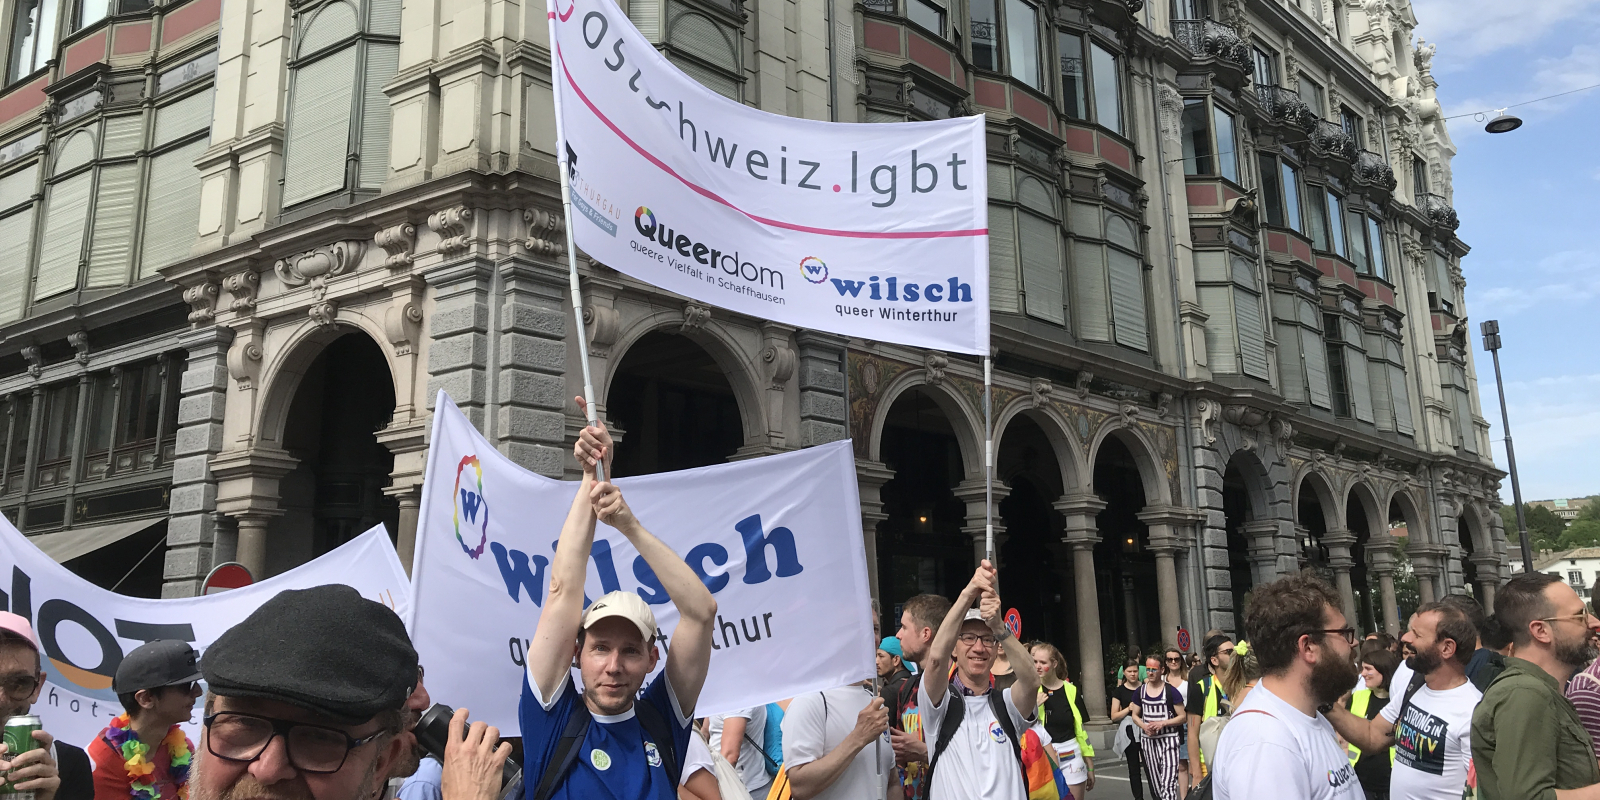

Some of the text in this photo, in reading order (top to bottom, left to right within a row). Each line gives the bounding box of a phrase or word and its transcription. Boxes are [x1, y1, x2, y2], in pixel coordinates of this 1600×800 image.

[580, 177, 621, 220] THURGAU
[592, 210, 614, 231] Friends
[634, 205, 784, 290] Queerdom
[630, 239, 786, 305] queere Vielfalt in Schaffhausen
[830, 275, 973, 302] wilsch
[835, 304, 958, 322] queer Winterthur
[490, 513, 804, 608] wlsch
[1403, 705, 1444, 738] STRONG IN
